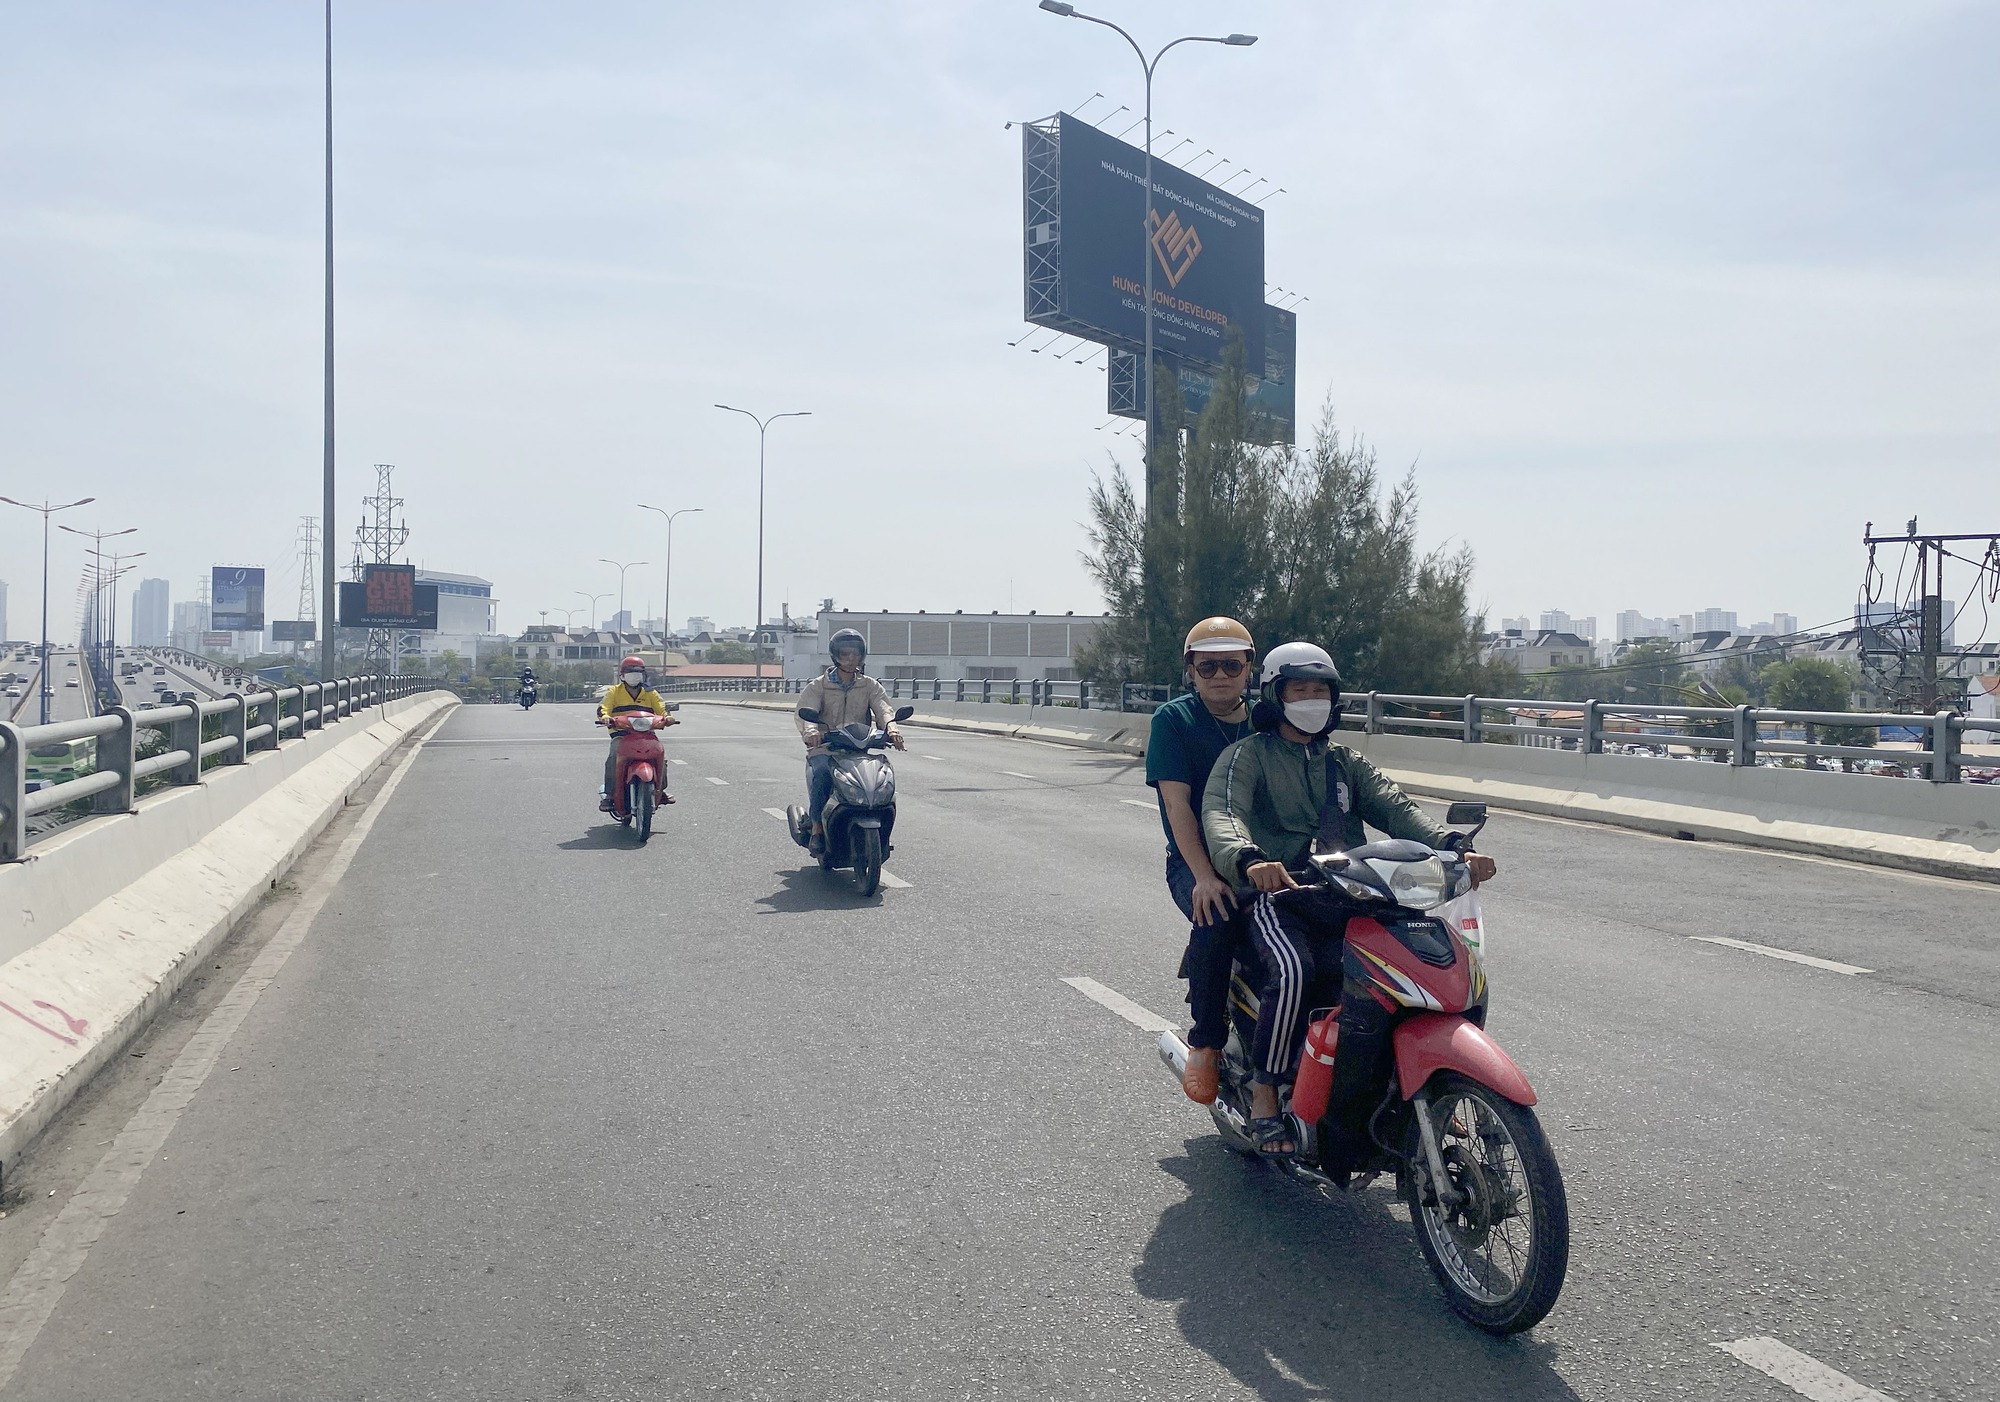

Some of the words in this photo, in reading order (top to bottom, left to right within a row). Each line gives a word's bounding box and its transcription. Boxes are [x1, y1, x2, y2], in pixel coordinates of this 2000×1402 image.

[1101, 159, 1115, 173] NHÀ
[1116, 166, 1133, 181] PHÁT
[1195, 203, 1217, 219] CHUYÊN
[1112, 275, 1141, 296] HƯNG
[1178, 299, 1228, 326] DEVELOPER
[229, 569, 246, 586] 9
[367, 584, 413, 600] GER
